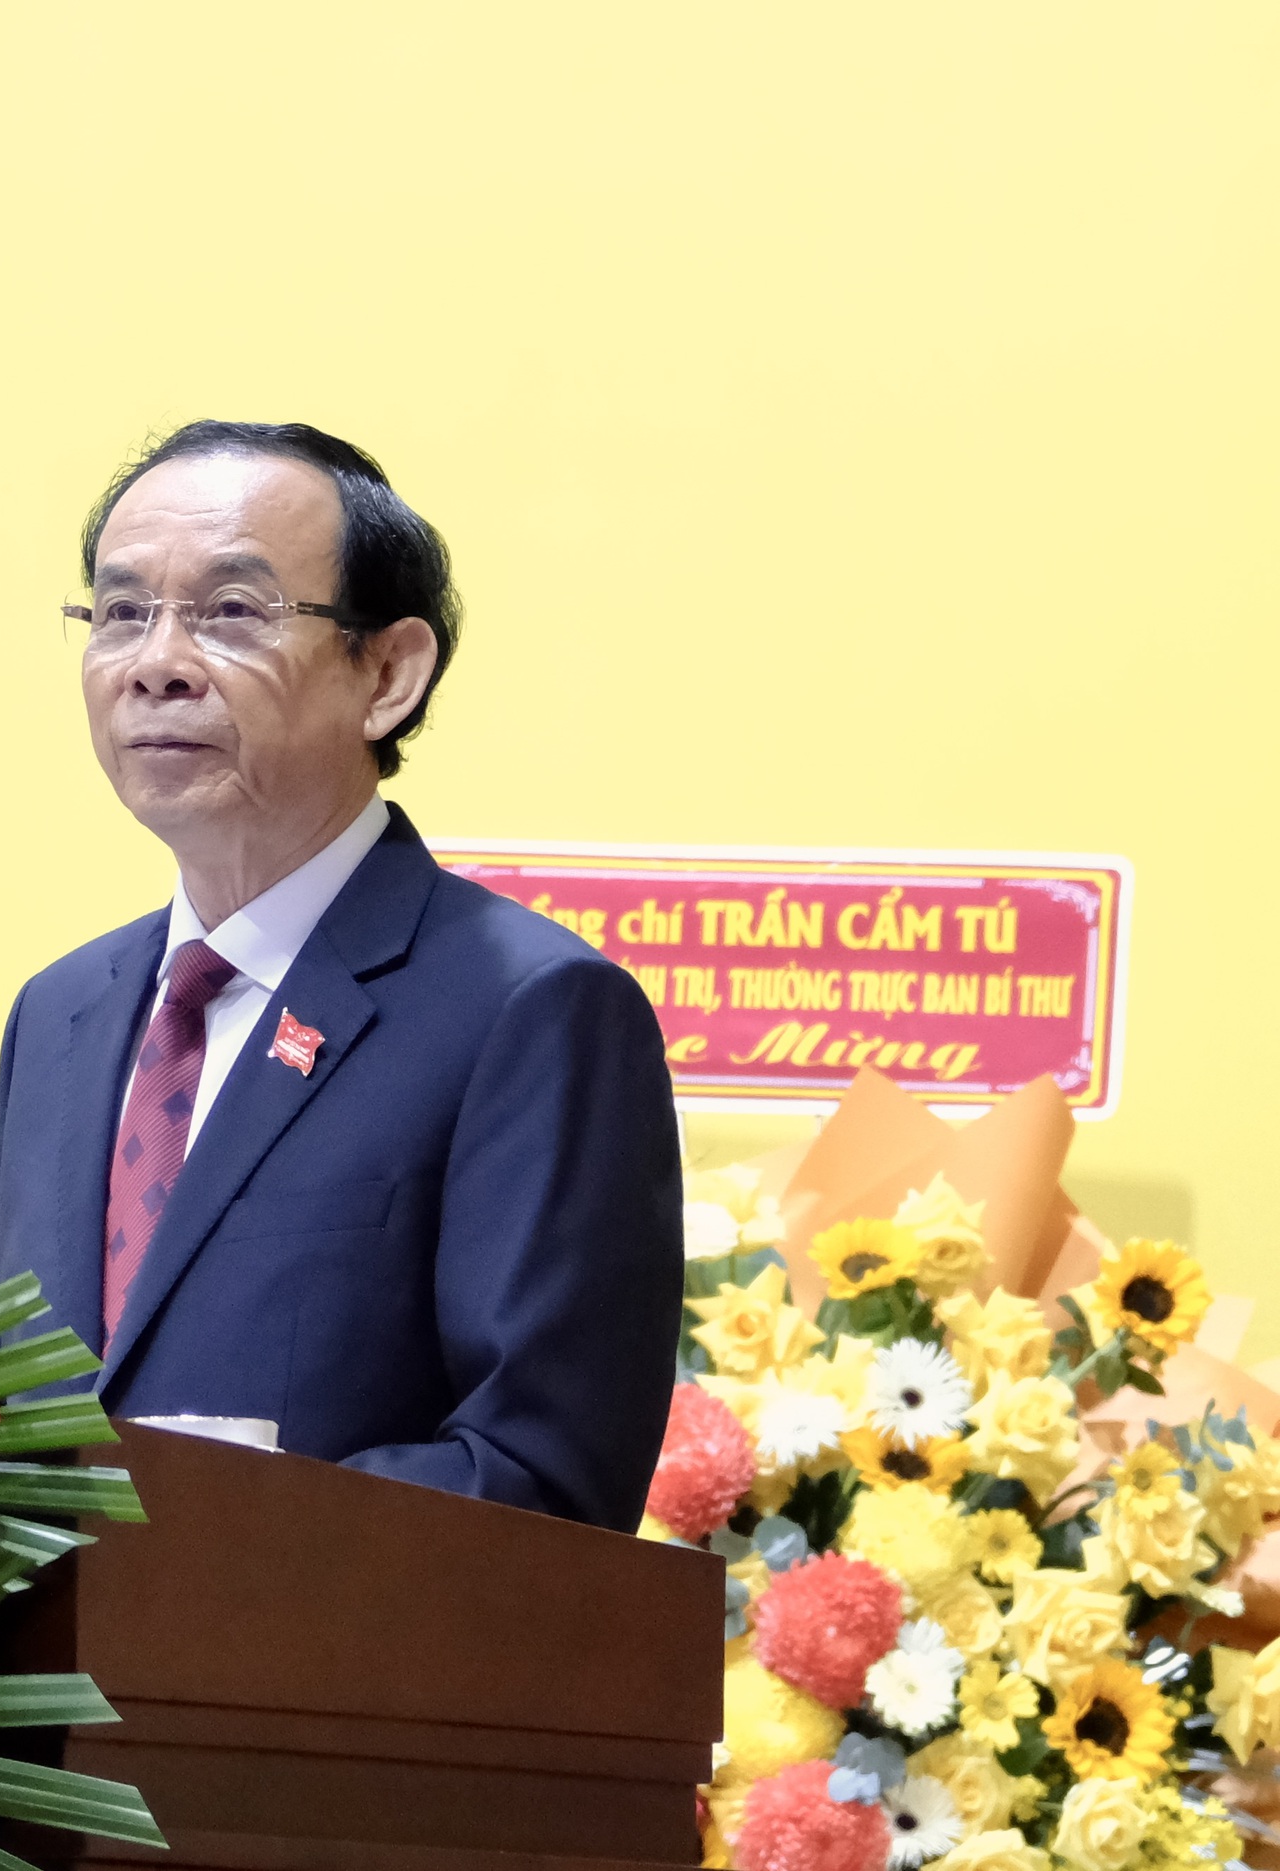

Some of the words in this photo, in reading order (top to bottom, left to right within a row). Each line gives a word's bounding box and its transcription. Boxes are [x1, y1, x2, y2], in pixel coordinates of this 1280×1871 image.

[618, 899, 685, 945] chí
[837, 886, 943, 951] CẨM
[955, 897, 1018, 953] TÚ
[729, 961, 843, 1012] THƯỜNG
[848, 969, 918, 1020] TRỰC
[922, 973, 980, 1015] BAN
[984, 966, 1014, 1016] BÍ
[1019, 975, 1077, 1018] THƯ
[729, 1021, 982, 1081] Mừng
